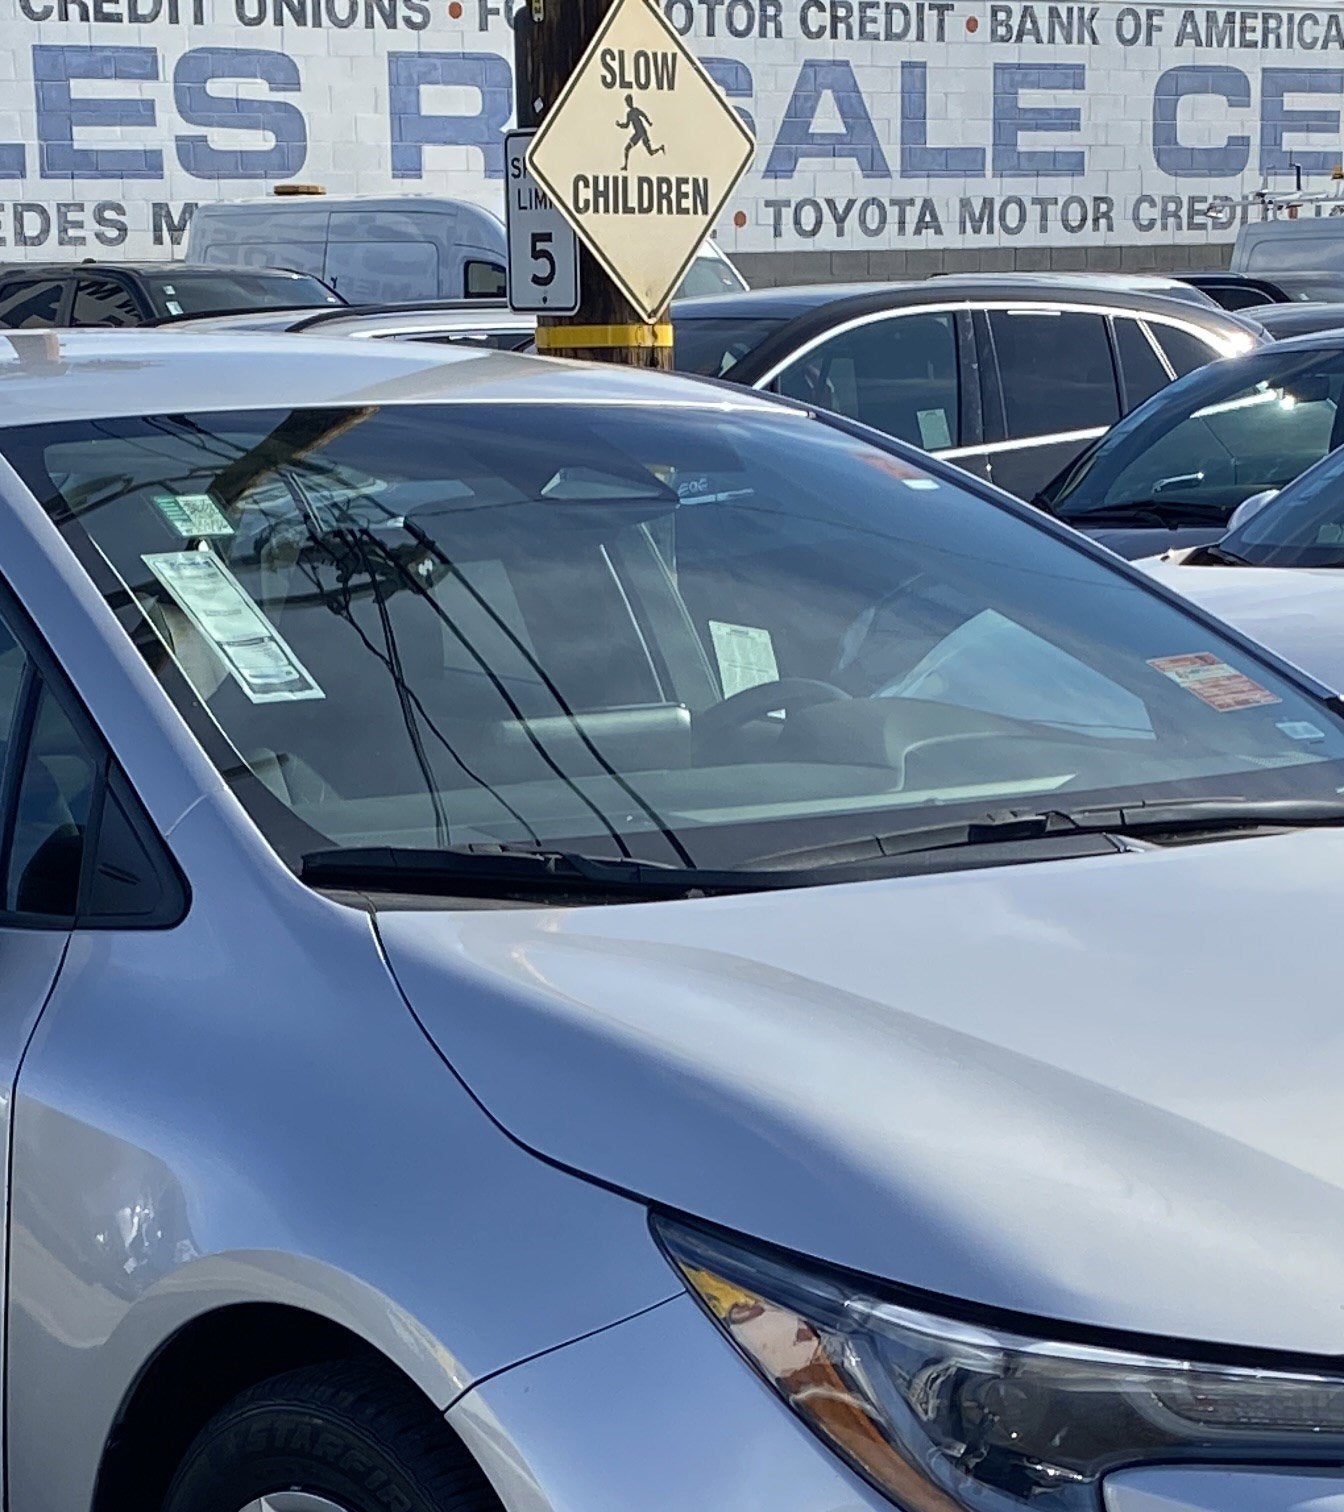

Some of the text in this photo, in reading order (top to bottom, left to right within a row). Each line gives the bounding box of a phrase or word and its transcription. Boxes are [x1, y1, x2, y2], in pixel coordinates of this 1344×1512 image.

[235, 0, 431, 30] UNIONS
[662, 0, 954, 42] OTOR CREDIT
[990, 4, 1100, 45] BANK
[1115, 7, 1165, 47] OF
[600, 48, 678, 91] SLOW
[517, 188, 554, 211] LIM
[572, 174, 709, 215] CHILDREN
[764, 197, 944, 238] TOYOTA
[958, 196, 1115, 235] MOTOR
[1132, 194, 1276, 232] CREDI
[530, 232, 556, 287] 5
